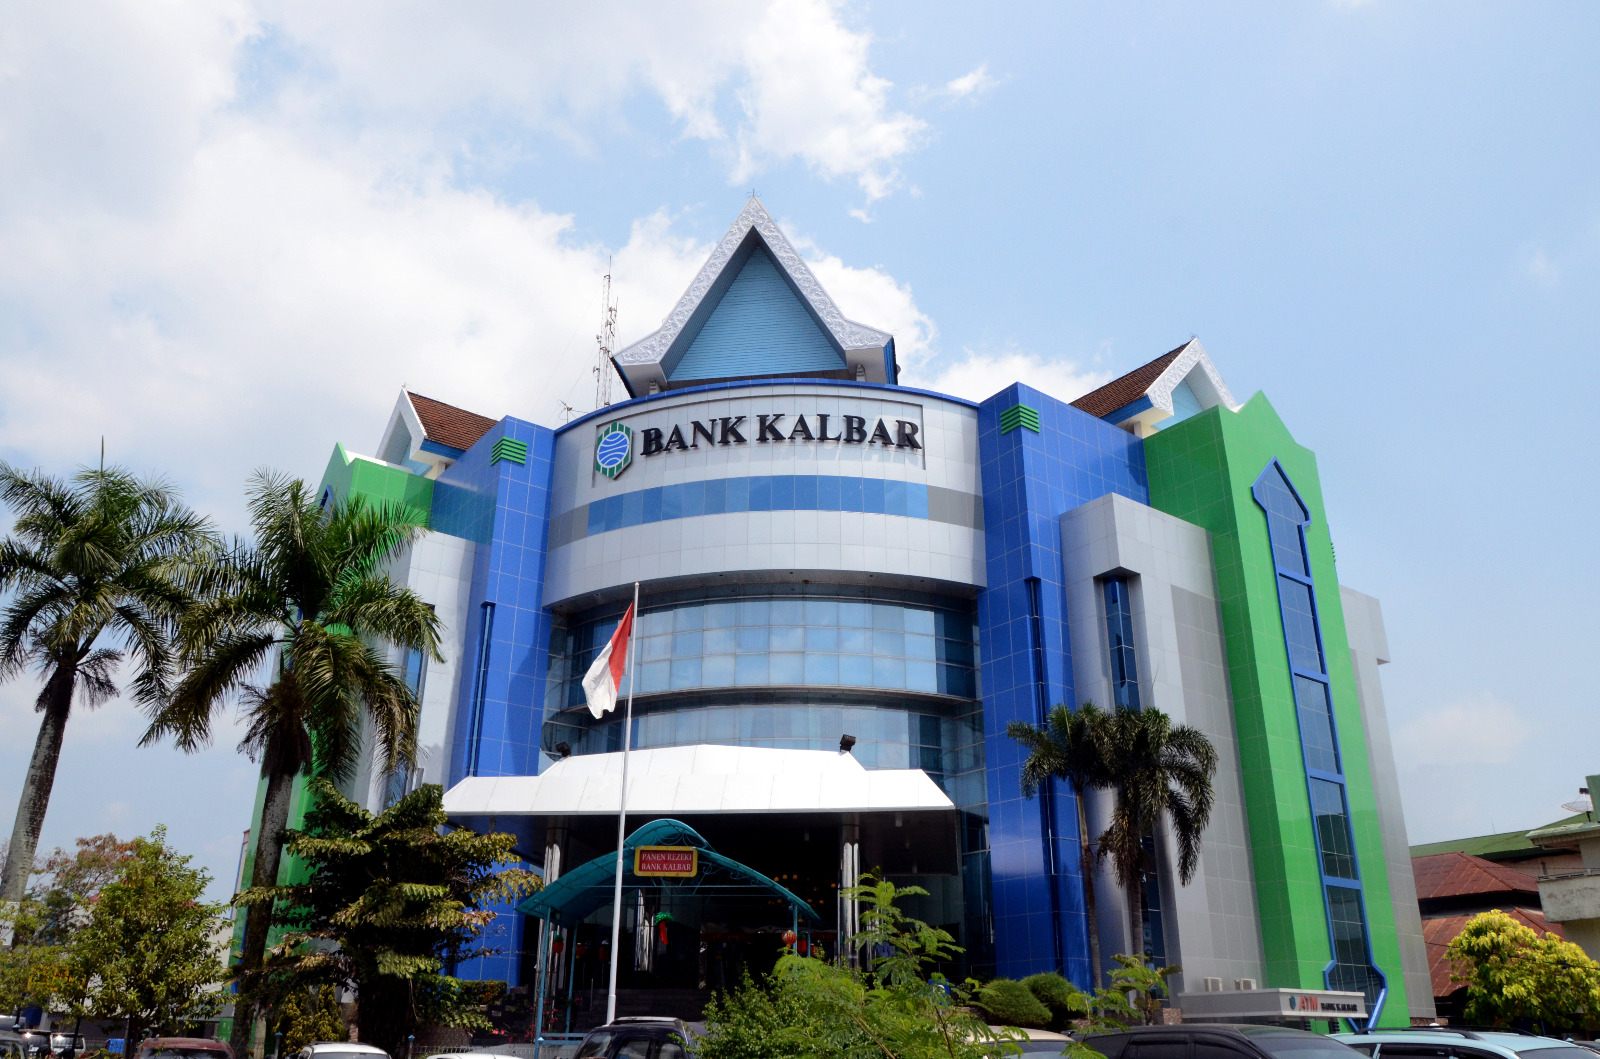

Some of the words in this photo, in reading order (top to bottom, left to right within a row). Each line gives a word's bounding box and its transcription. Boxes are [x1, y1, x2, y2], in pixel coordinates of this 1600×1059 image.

[640, 416, 748, 456] BANK
[756, 413, 923, 450] KALBAR
[642, 853, 666, 861] PANEN
[667, 853, 692, 861] REZEKI
[663, 863, 691, 871] KALBAR
[1299, 996, 1318, 1010] ATM
